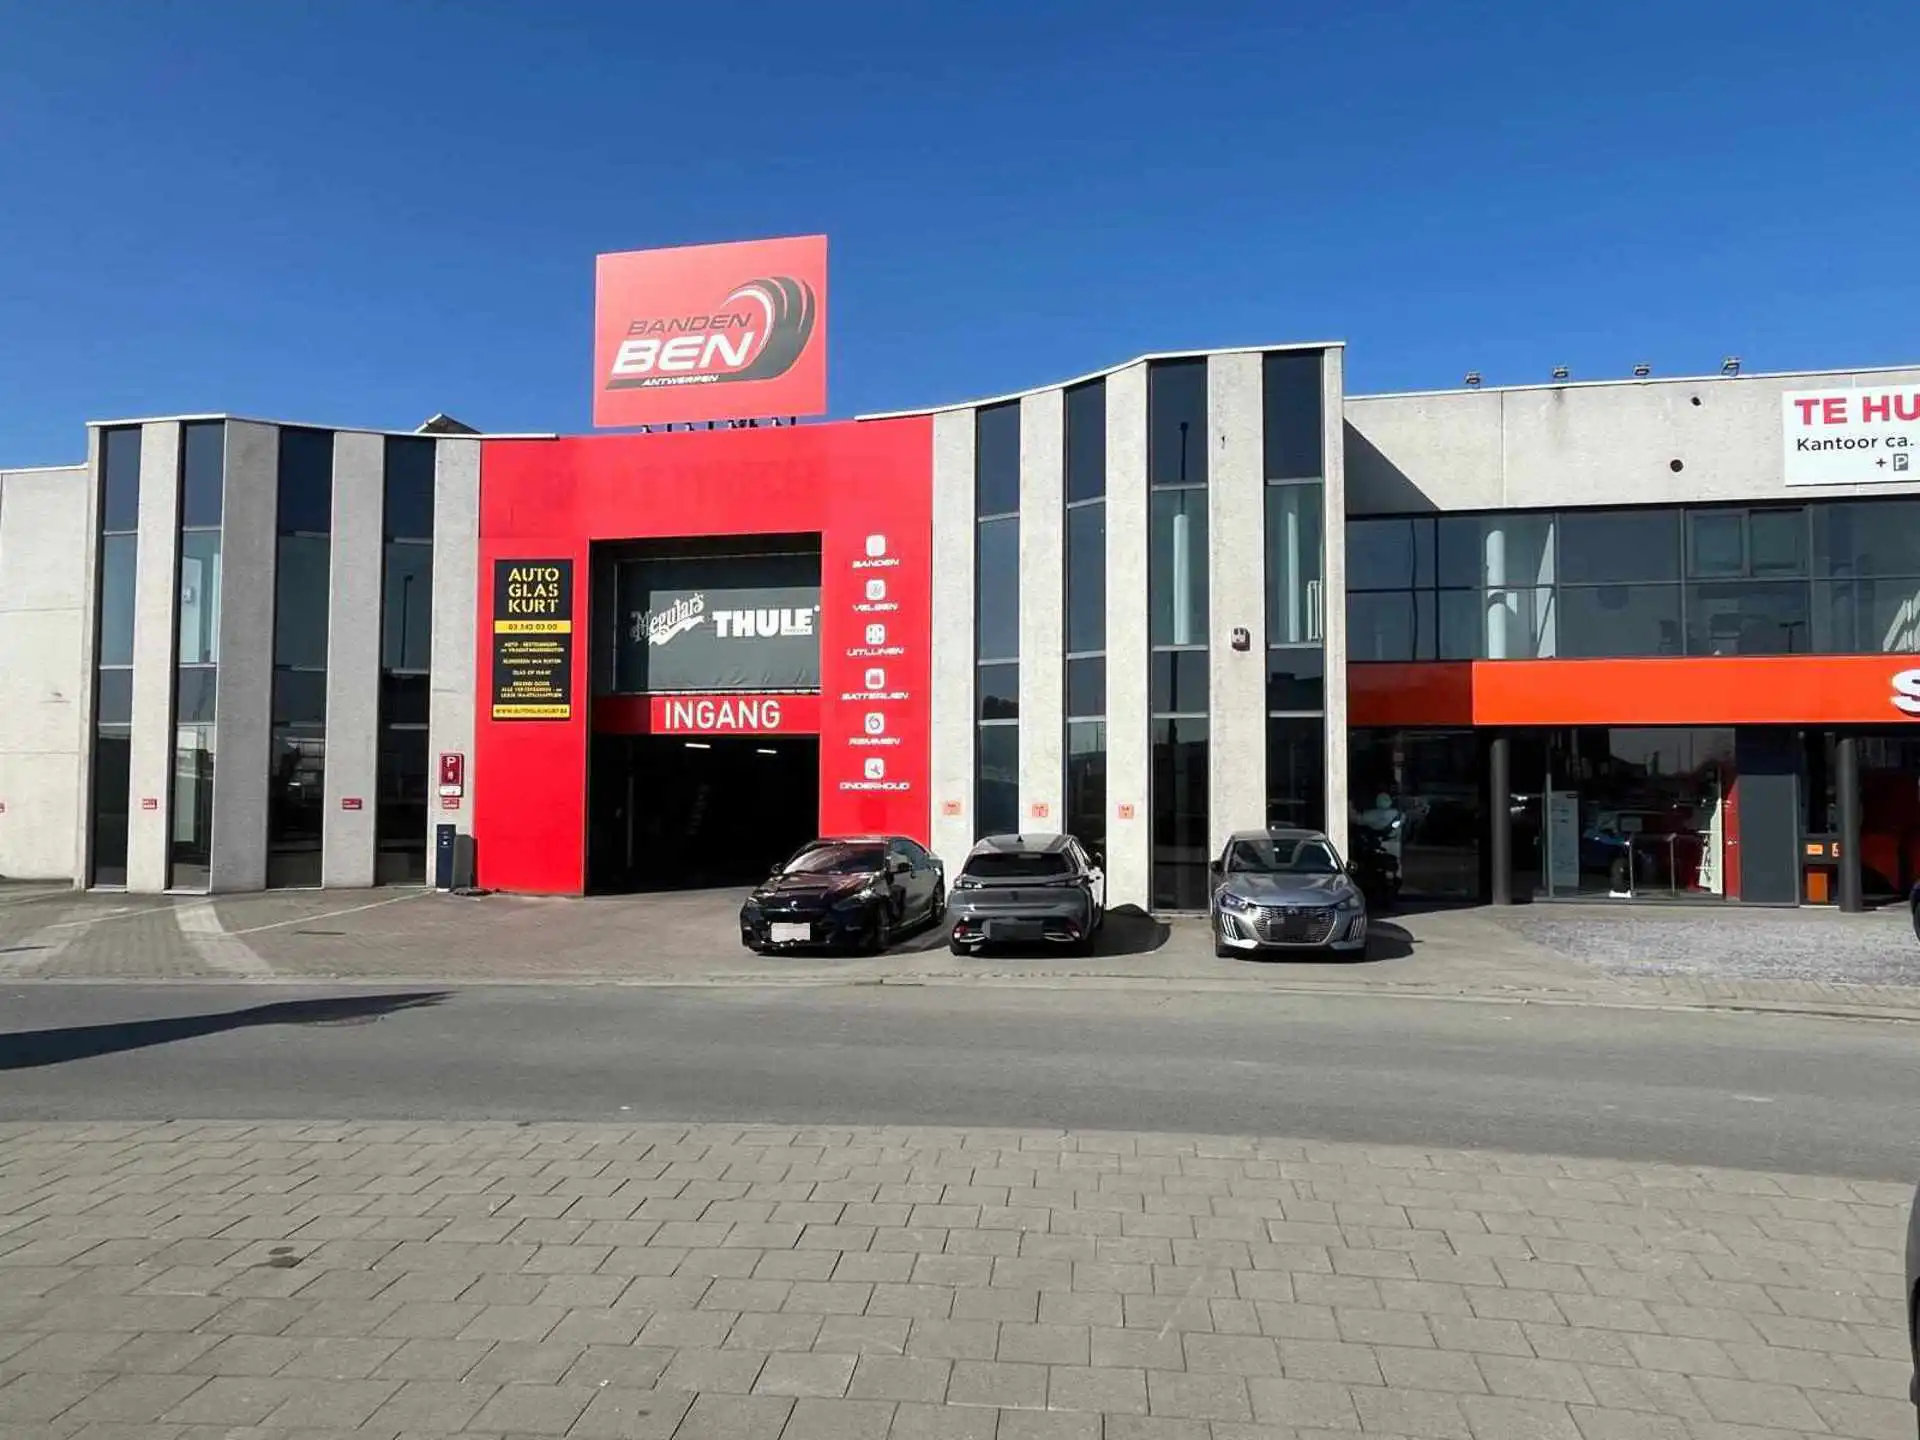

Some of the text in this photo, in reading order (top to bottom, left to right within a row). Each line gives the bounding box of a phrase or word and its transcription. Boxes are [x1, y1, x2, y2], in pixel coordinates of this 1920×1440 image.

[626, 313, 752, 336] BANDEN
[611, 331, 755, 374] BEN
[641, 374, 720, 387] ANTWERPEN
[1794, 393, 1920, 425] TE HU
[1797, 436, 1914, 452] Kantoor ca.
[508, 568, 559, 582] AUTO
[508, 583, 559, 598] GLAS
[508, 599, 559, 613] KURT
[712, 607, 813, 638] THULE
[665, 700, 781, 729] INGANG
[446, 756, 457, 768] P
